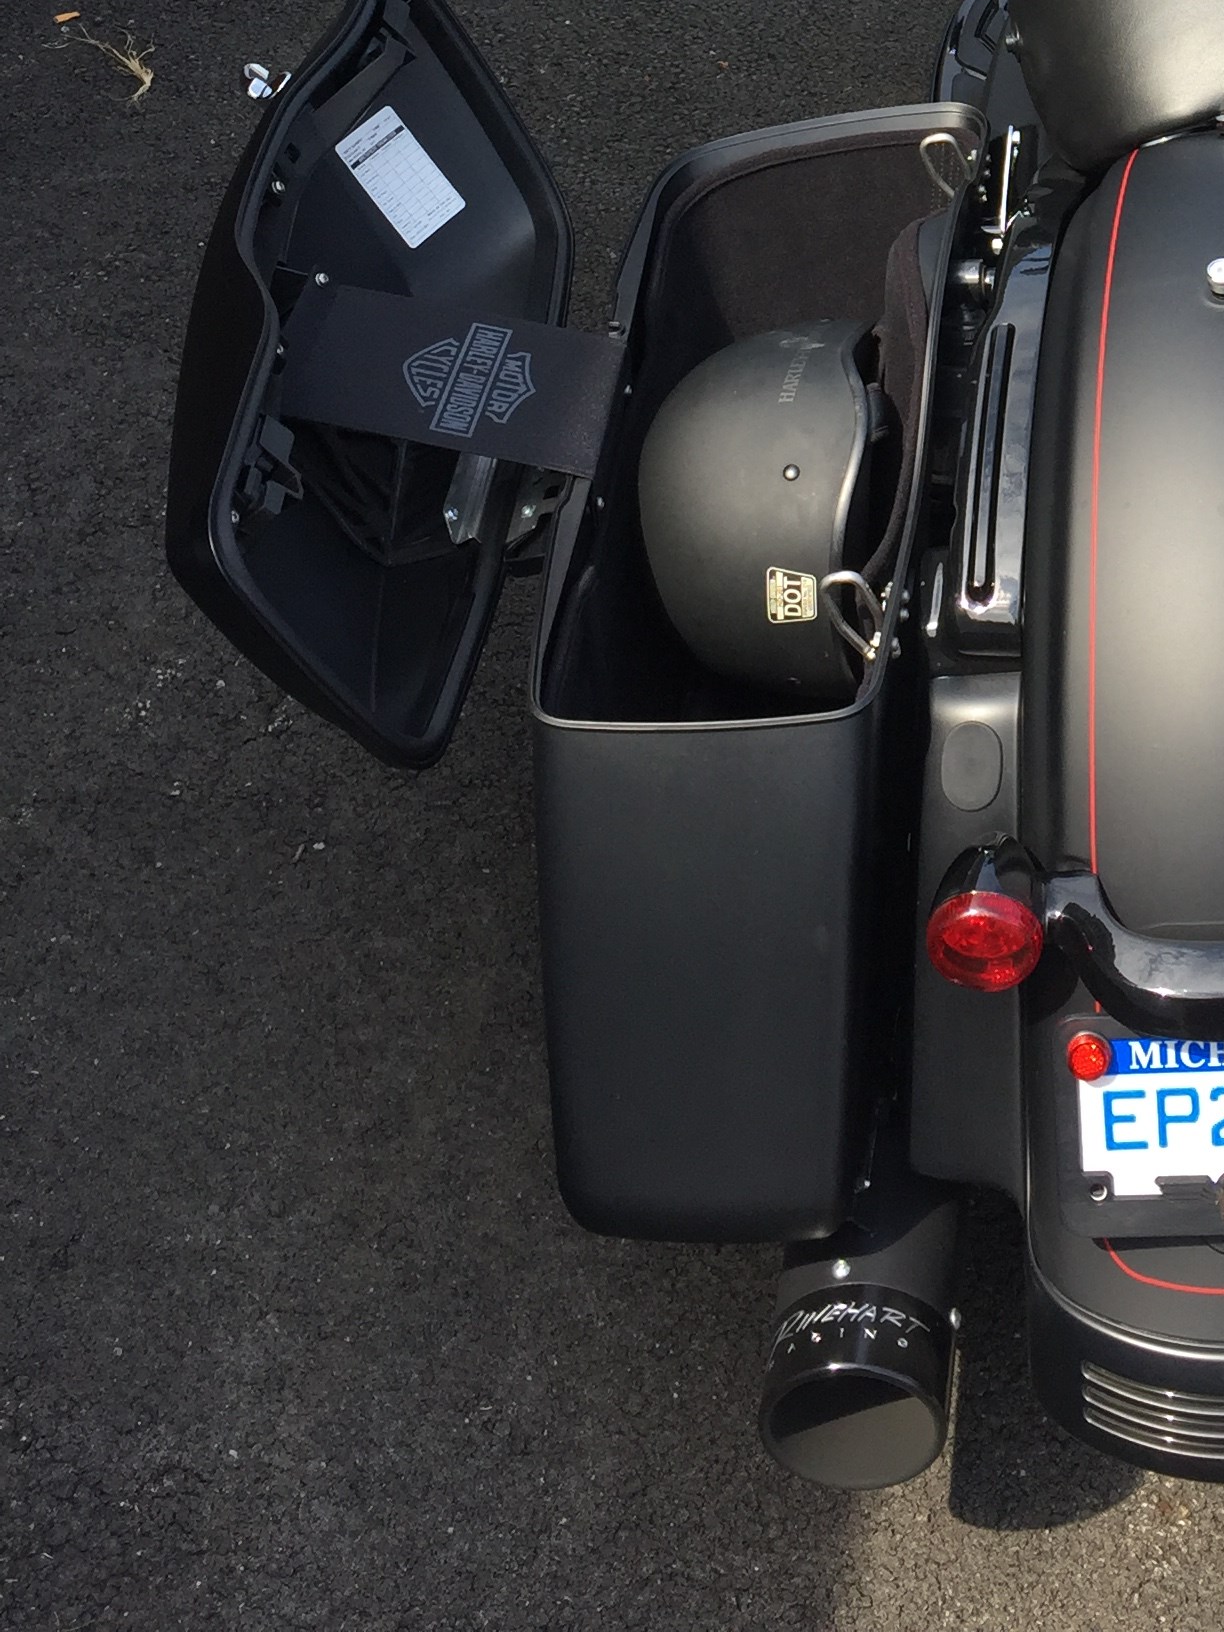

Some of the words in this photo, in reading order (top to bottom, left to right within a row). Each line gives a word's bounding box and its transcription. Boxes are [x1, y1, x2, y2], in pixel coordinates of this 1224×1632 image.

[410, 345, 458, 399] CYCLES
[440, 328, 504, 431] HARLEY-DAVIDSON
[487, 358, 528, 413] MOTOR
[783, 576, 802, 616] DOT
